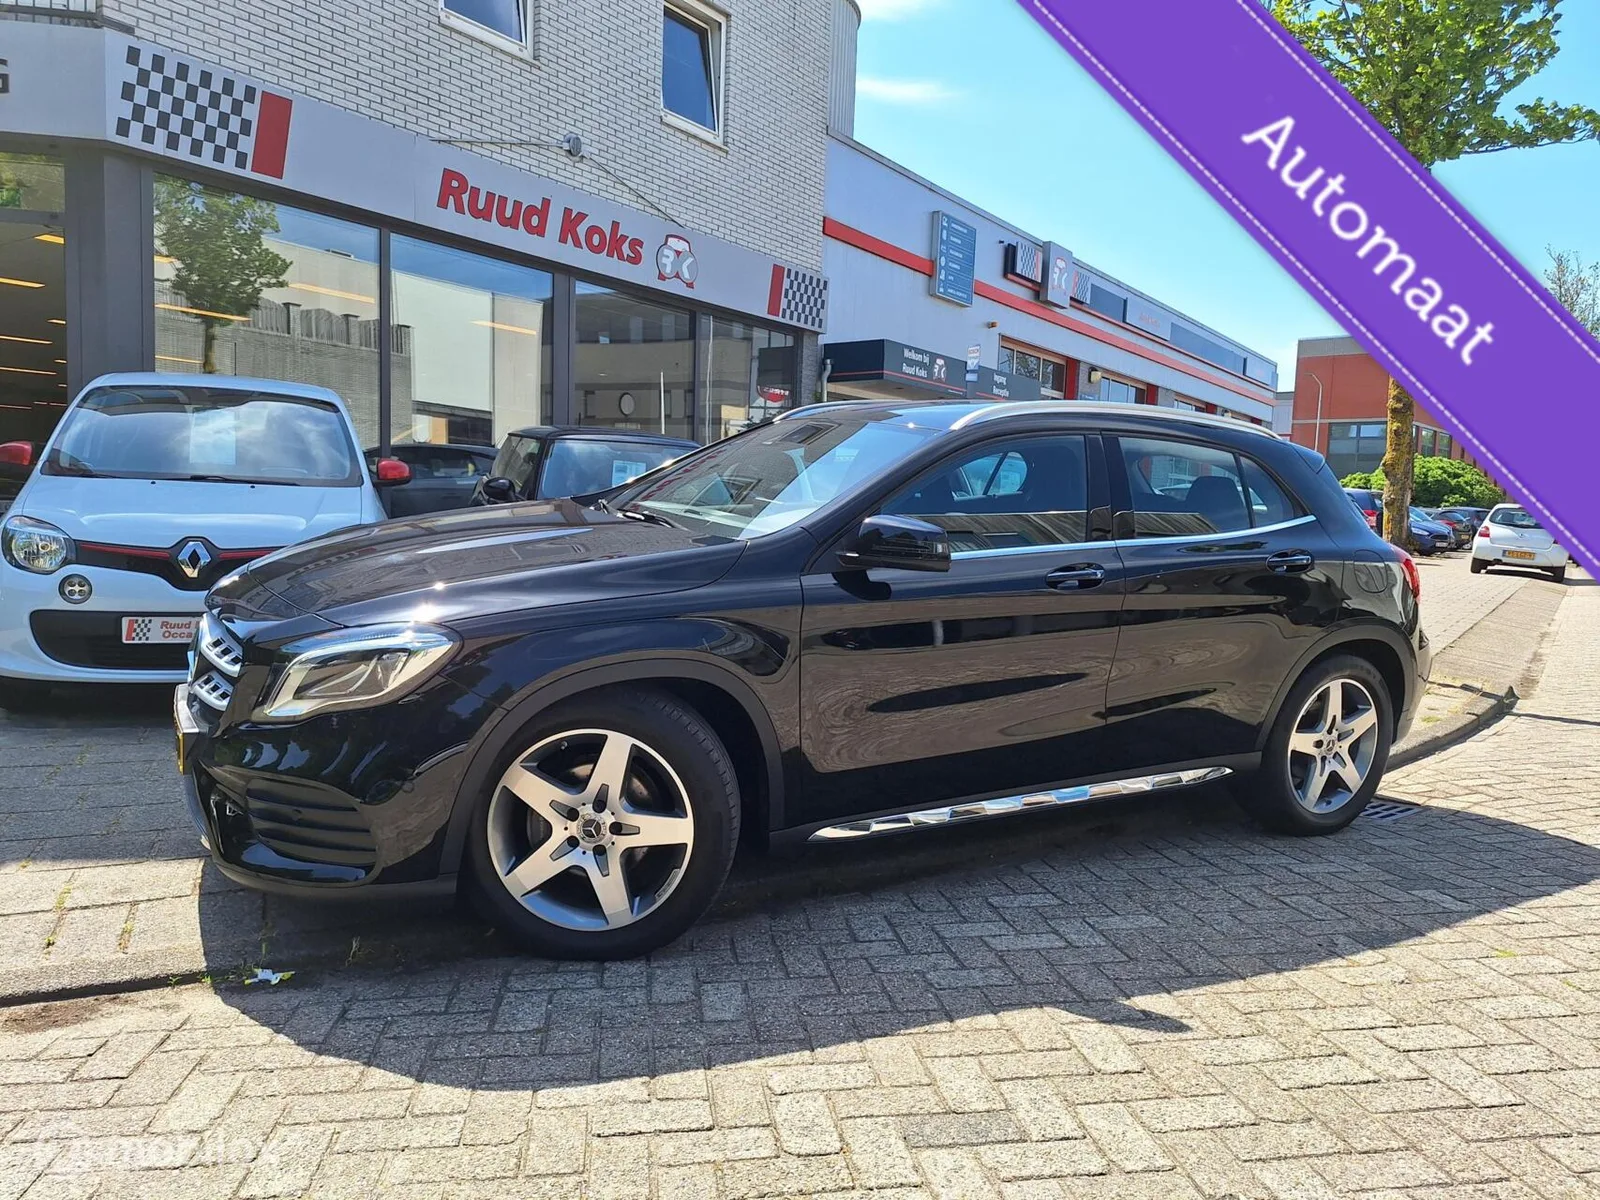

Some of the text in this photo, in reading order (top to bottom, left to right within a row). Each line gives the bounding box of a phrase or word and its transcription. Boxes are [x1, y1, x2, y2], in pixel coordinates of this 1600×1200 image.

[436, 167, 645, 266] Ruud Koks
[160, 620, 192, 630] Ruud
